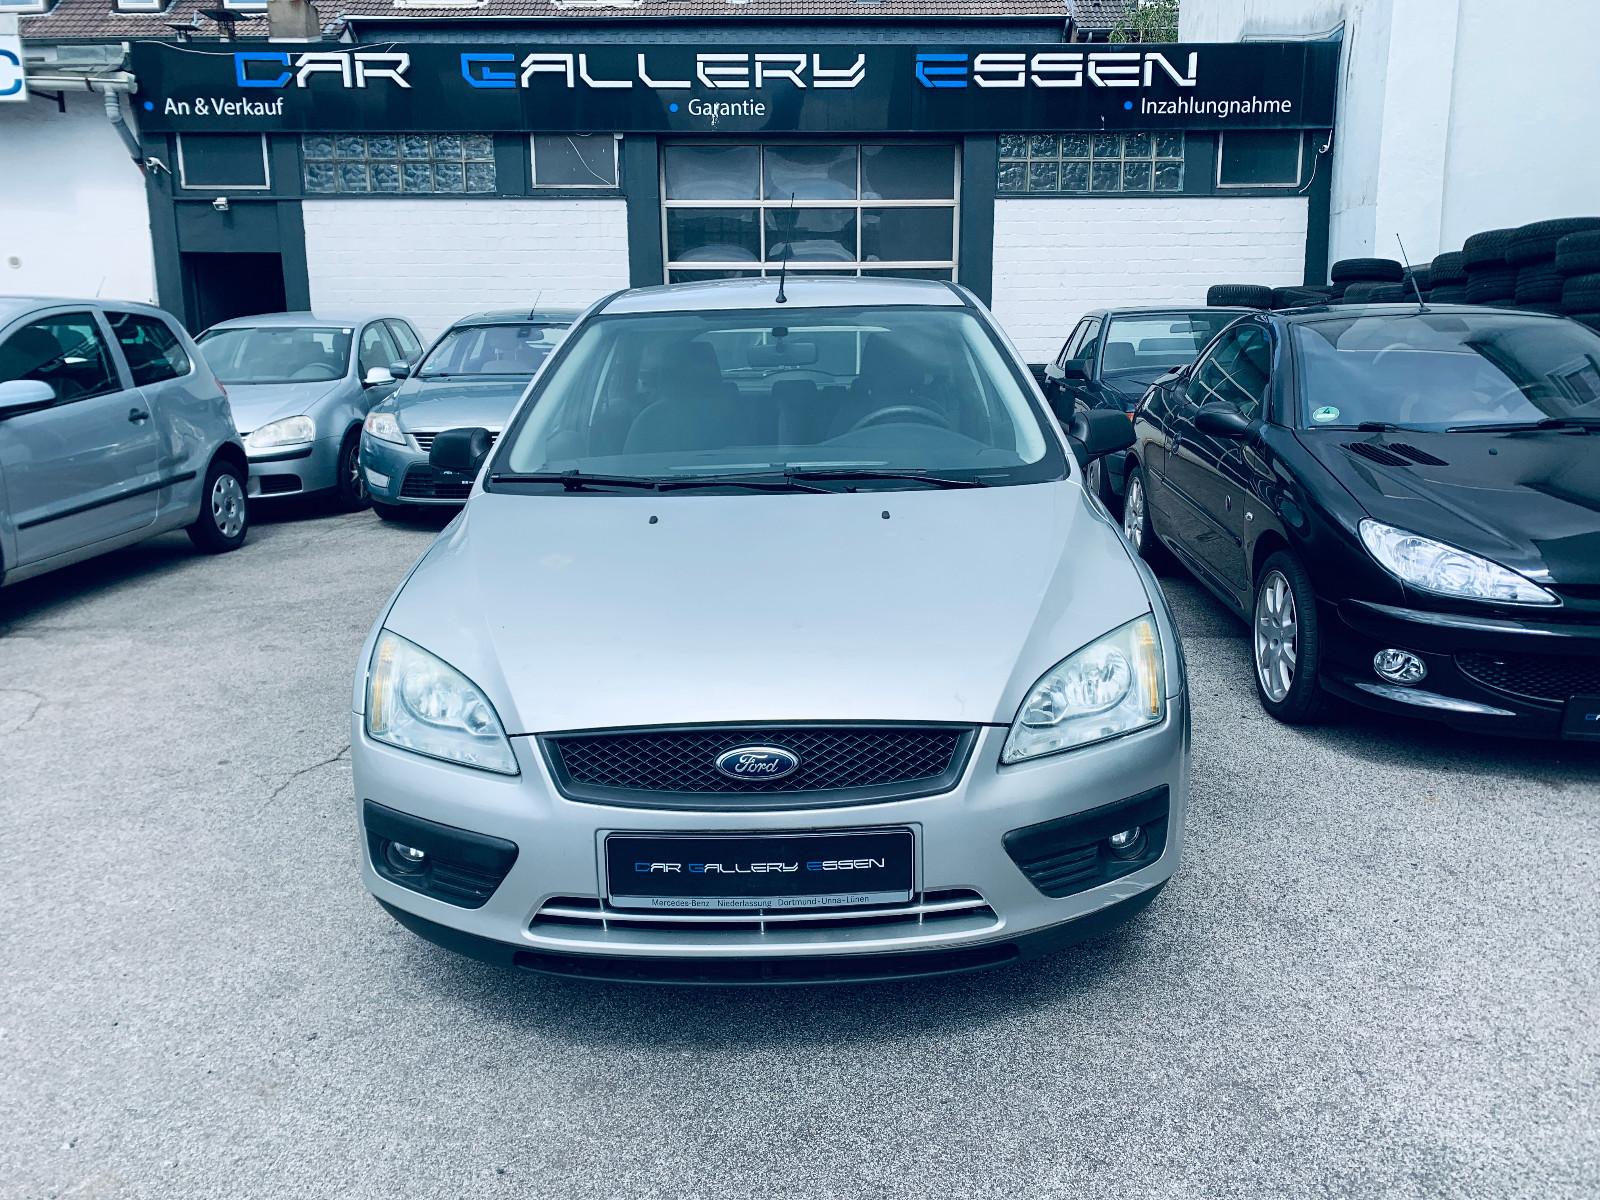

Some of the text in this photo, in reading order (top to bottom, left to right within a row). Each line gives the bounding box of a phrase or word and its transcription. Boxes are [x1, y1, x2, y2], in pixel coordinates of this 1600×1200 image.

[234, 51, 1197, 90] CAR GALLERY ESSEN
[164, 96, 284, 117] An & Verkauf
[687, 99, 766, 117] Garantie
[1141, 97, 1293, 119] Inzahlungnahme
[734, 754, 779, 773] Ford
[634, 857, 885, 873] CAR GALLERY ESSEN
[651, 898, 710, 908] Mercedes-Benz
[717, 899, 772, 910] Niederlassung
